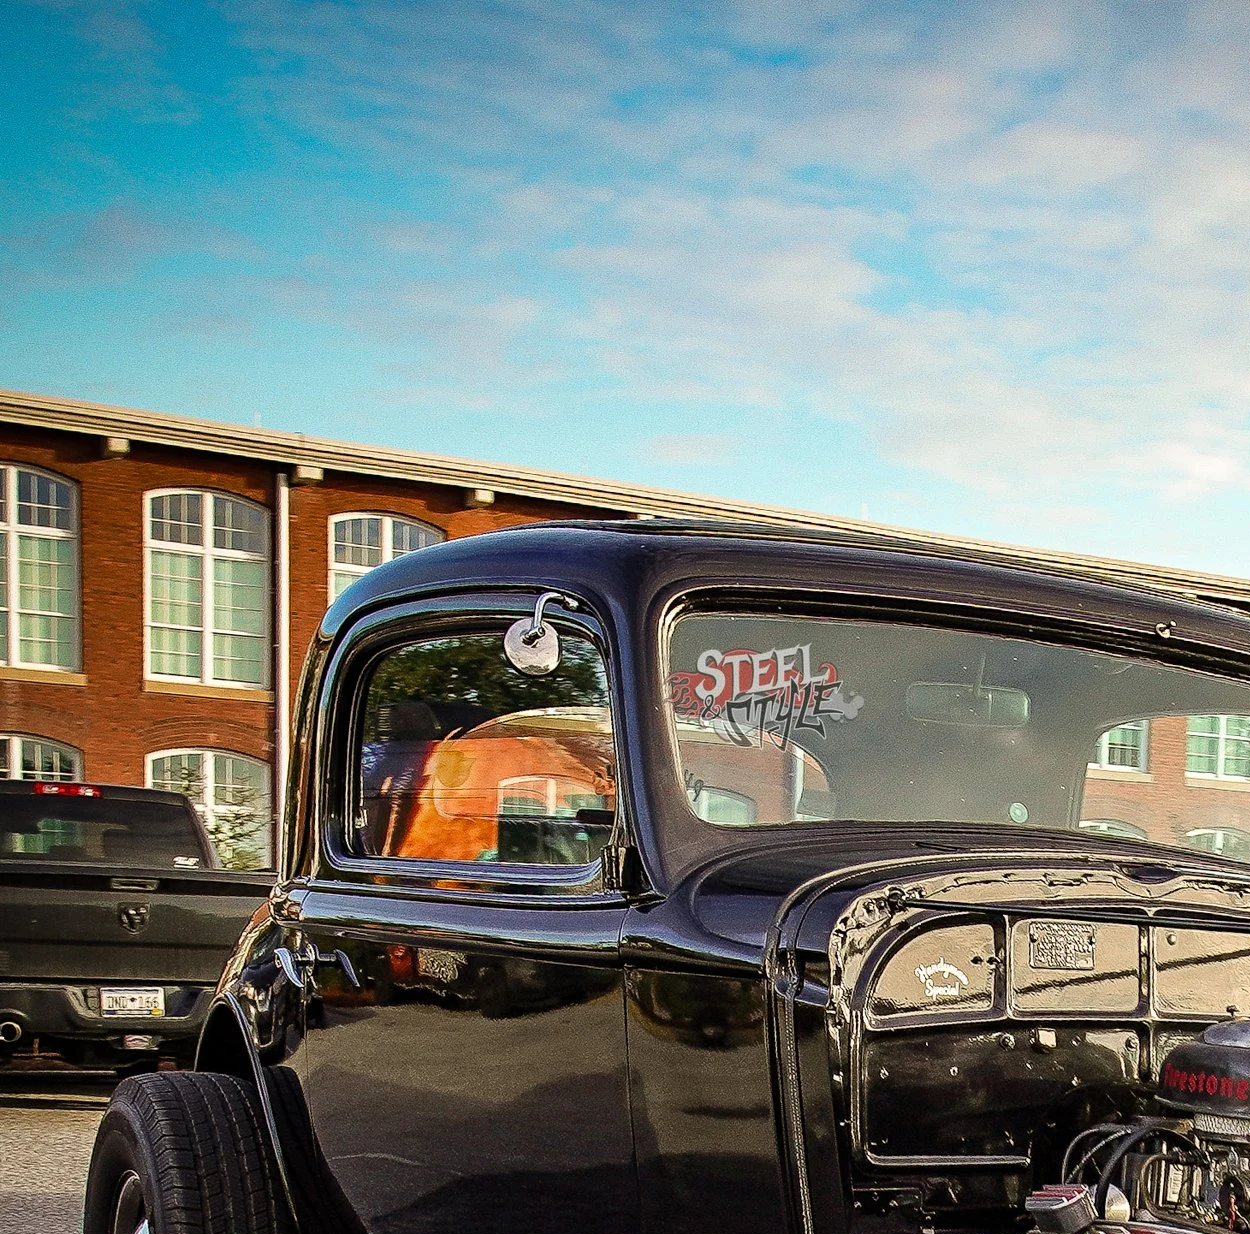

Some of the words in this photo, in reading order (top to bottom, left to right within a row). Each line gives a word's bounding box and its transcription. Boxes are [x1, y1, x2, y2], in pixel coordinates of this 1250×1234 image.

[695, 643, 829, 700] STEEL
[701, 695, 721, 719] &
[725, 679, 844, 751] STYLE
[1164, 1063, 1249, 1100] Firestone
